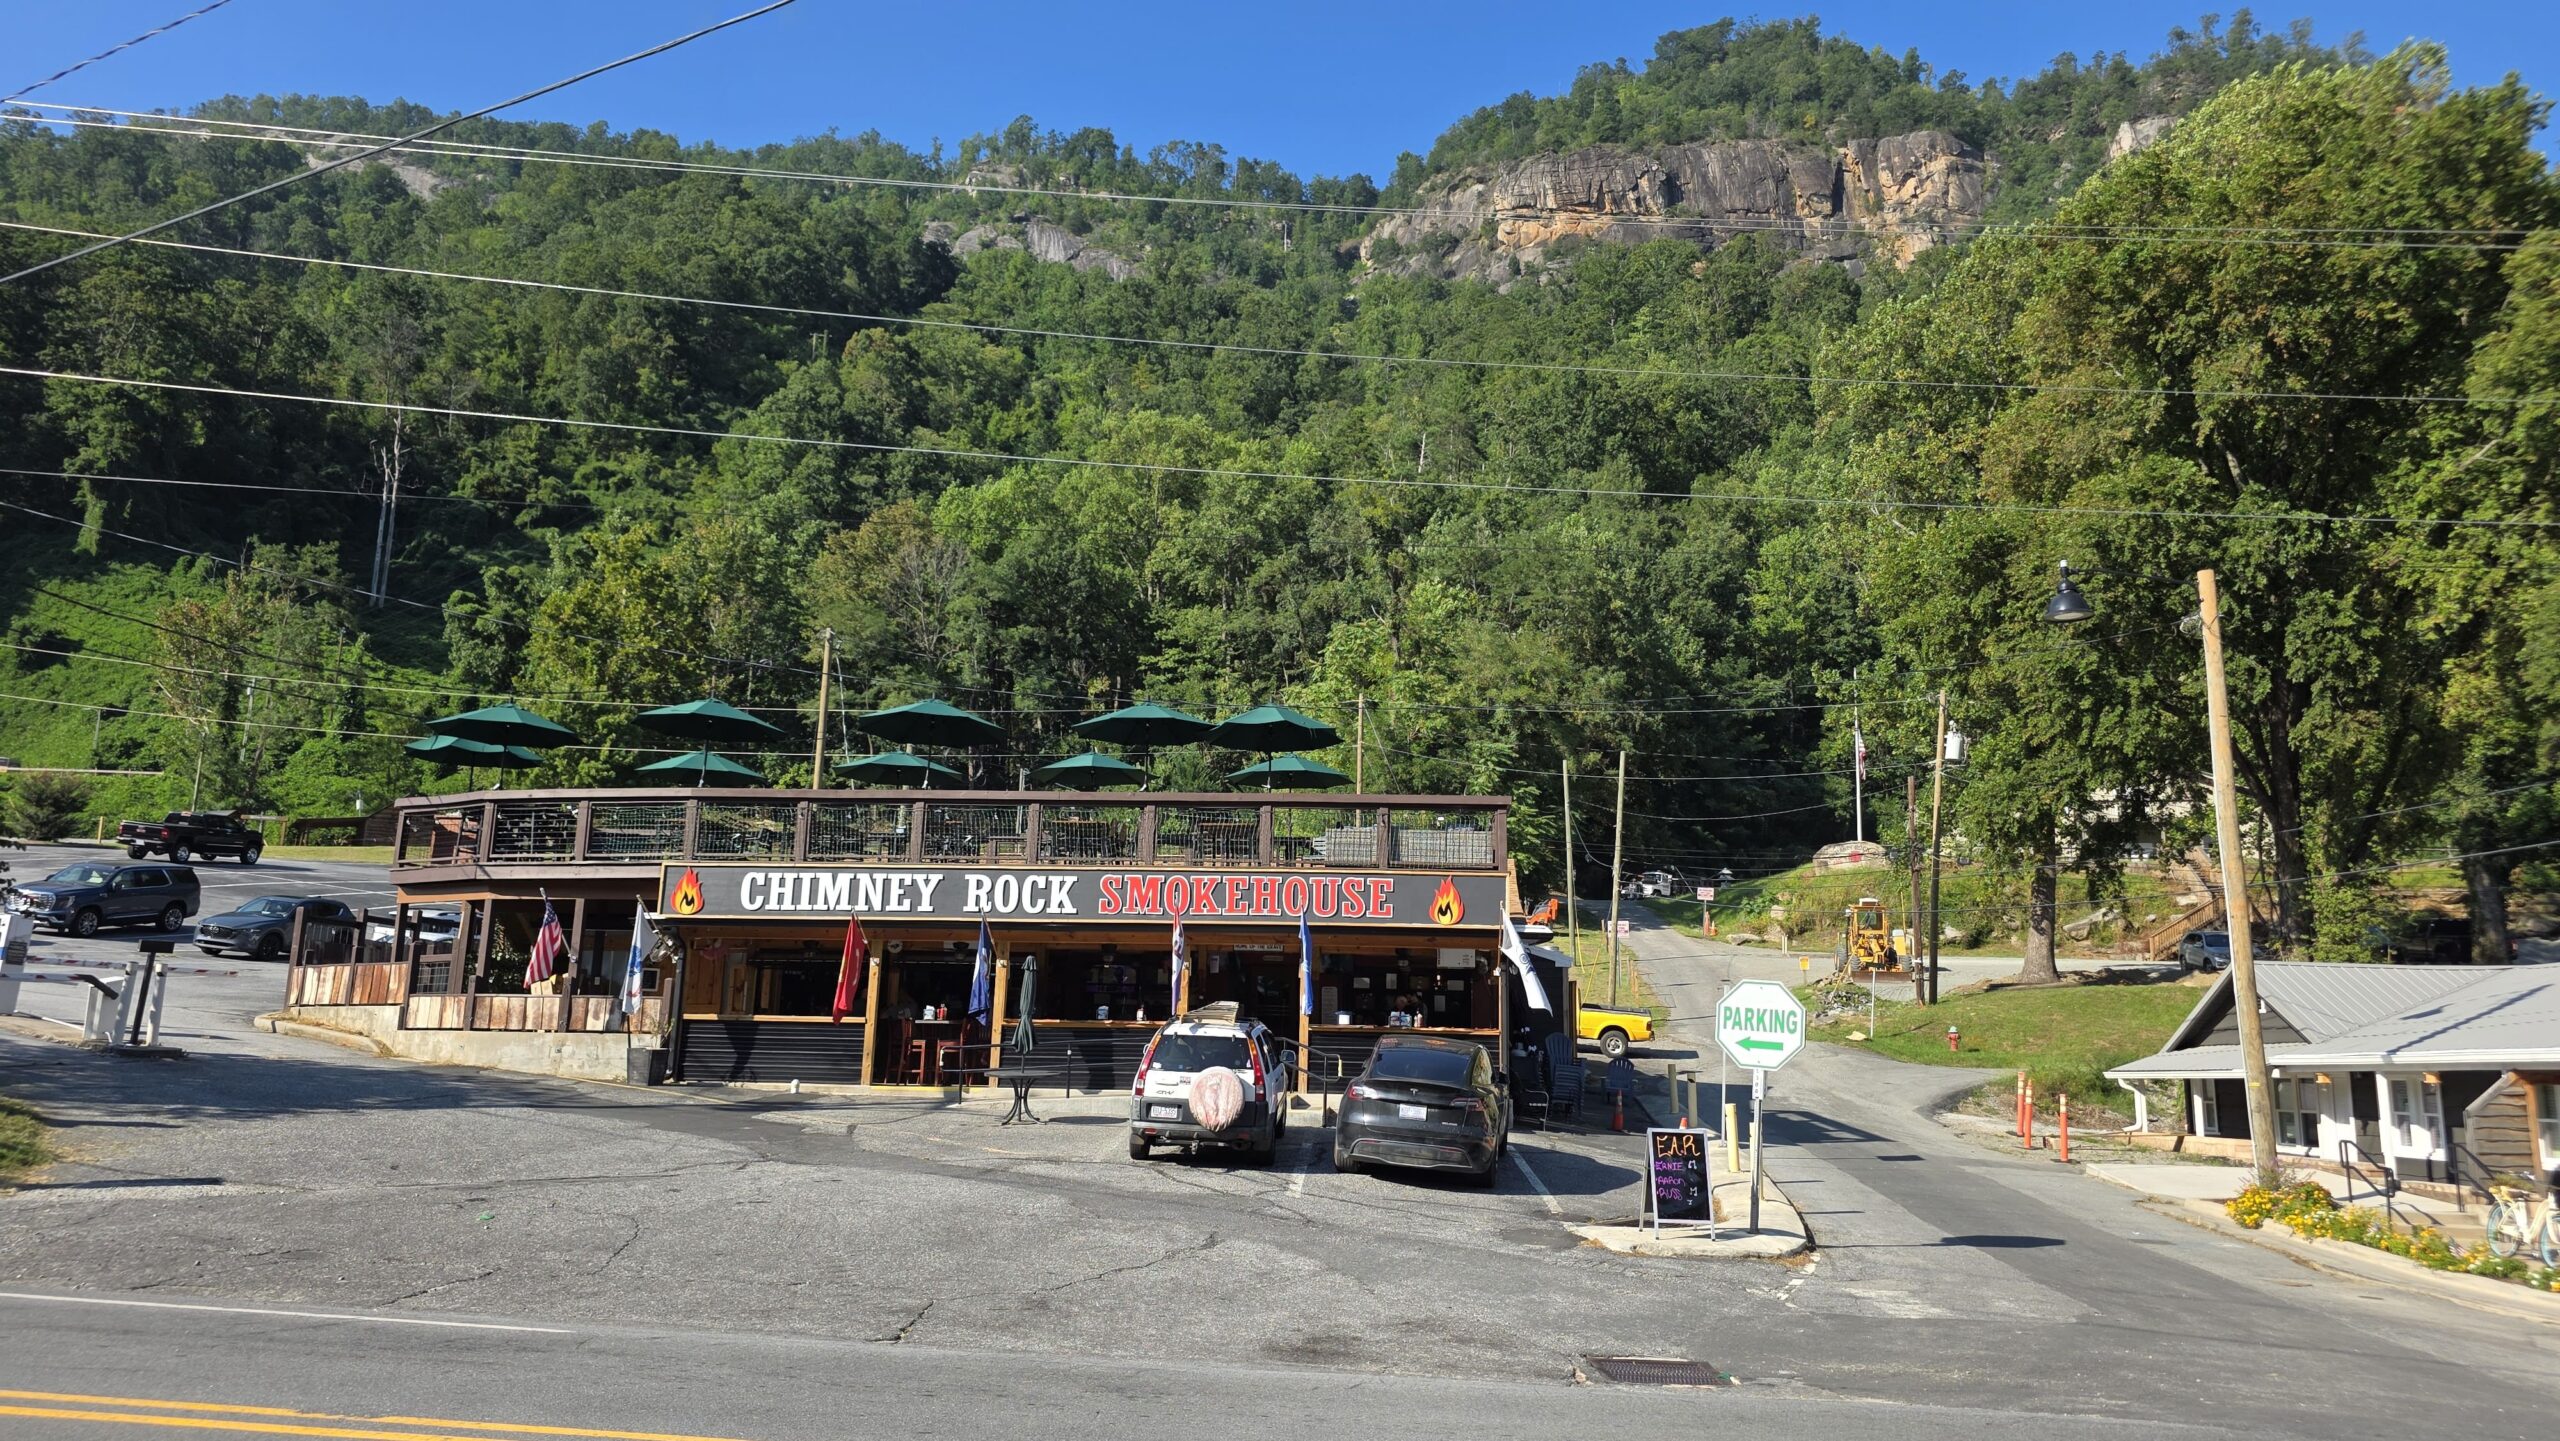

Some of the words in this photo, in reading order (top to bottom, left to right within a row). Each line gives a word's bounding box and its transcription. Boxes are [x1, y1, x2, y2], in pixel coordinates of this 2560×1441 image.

[740, 871, 944, 912] CHIMNEY
[962, 873, 1079, 915] ROCK
[1098, 874, 1395, 918] SMOKEHOUSE
[1723, 1006, 1798, 1035] PARKING
